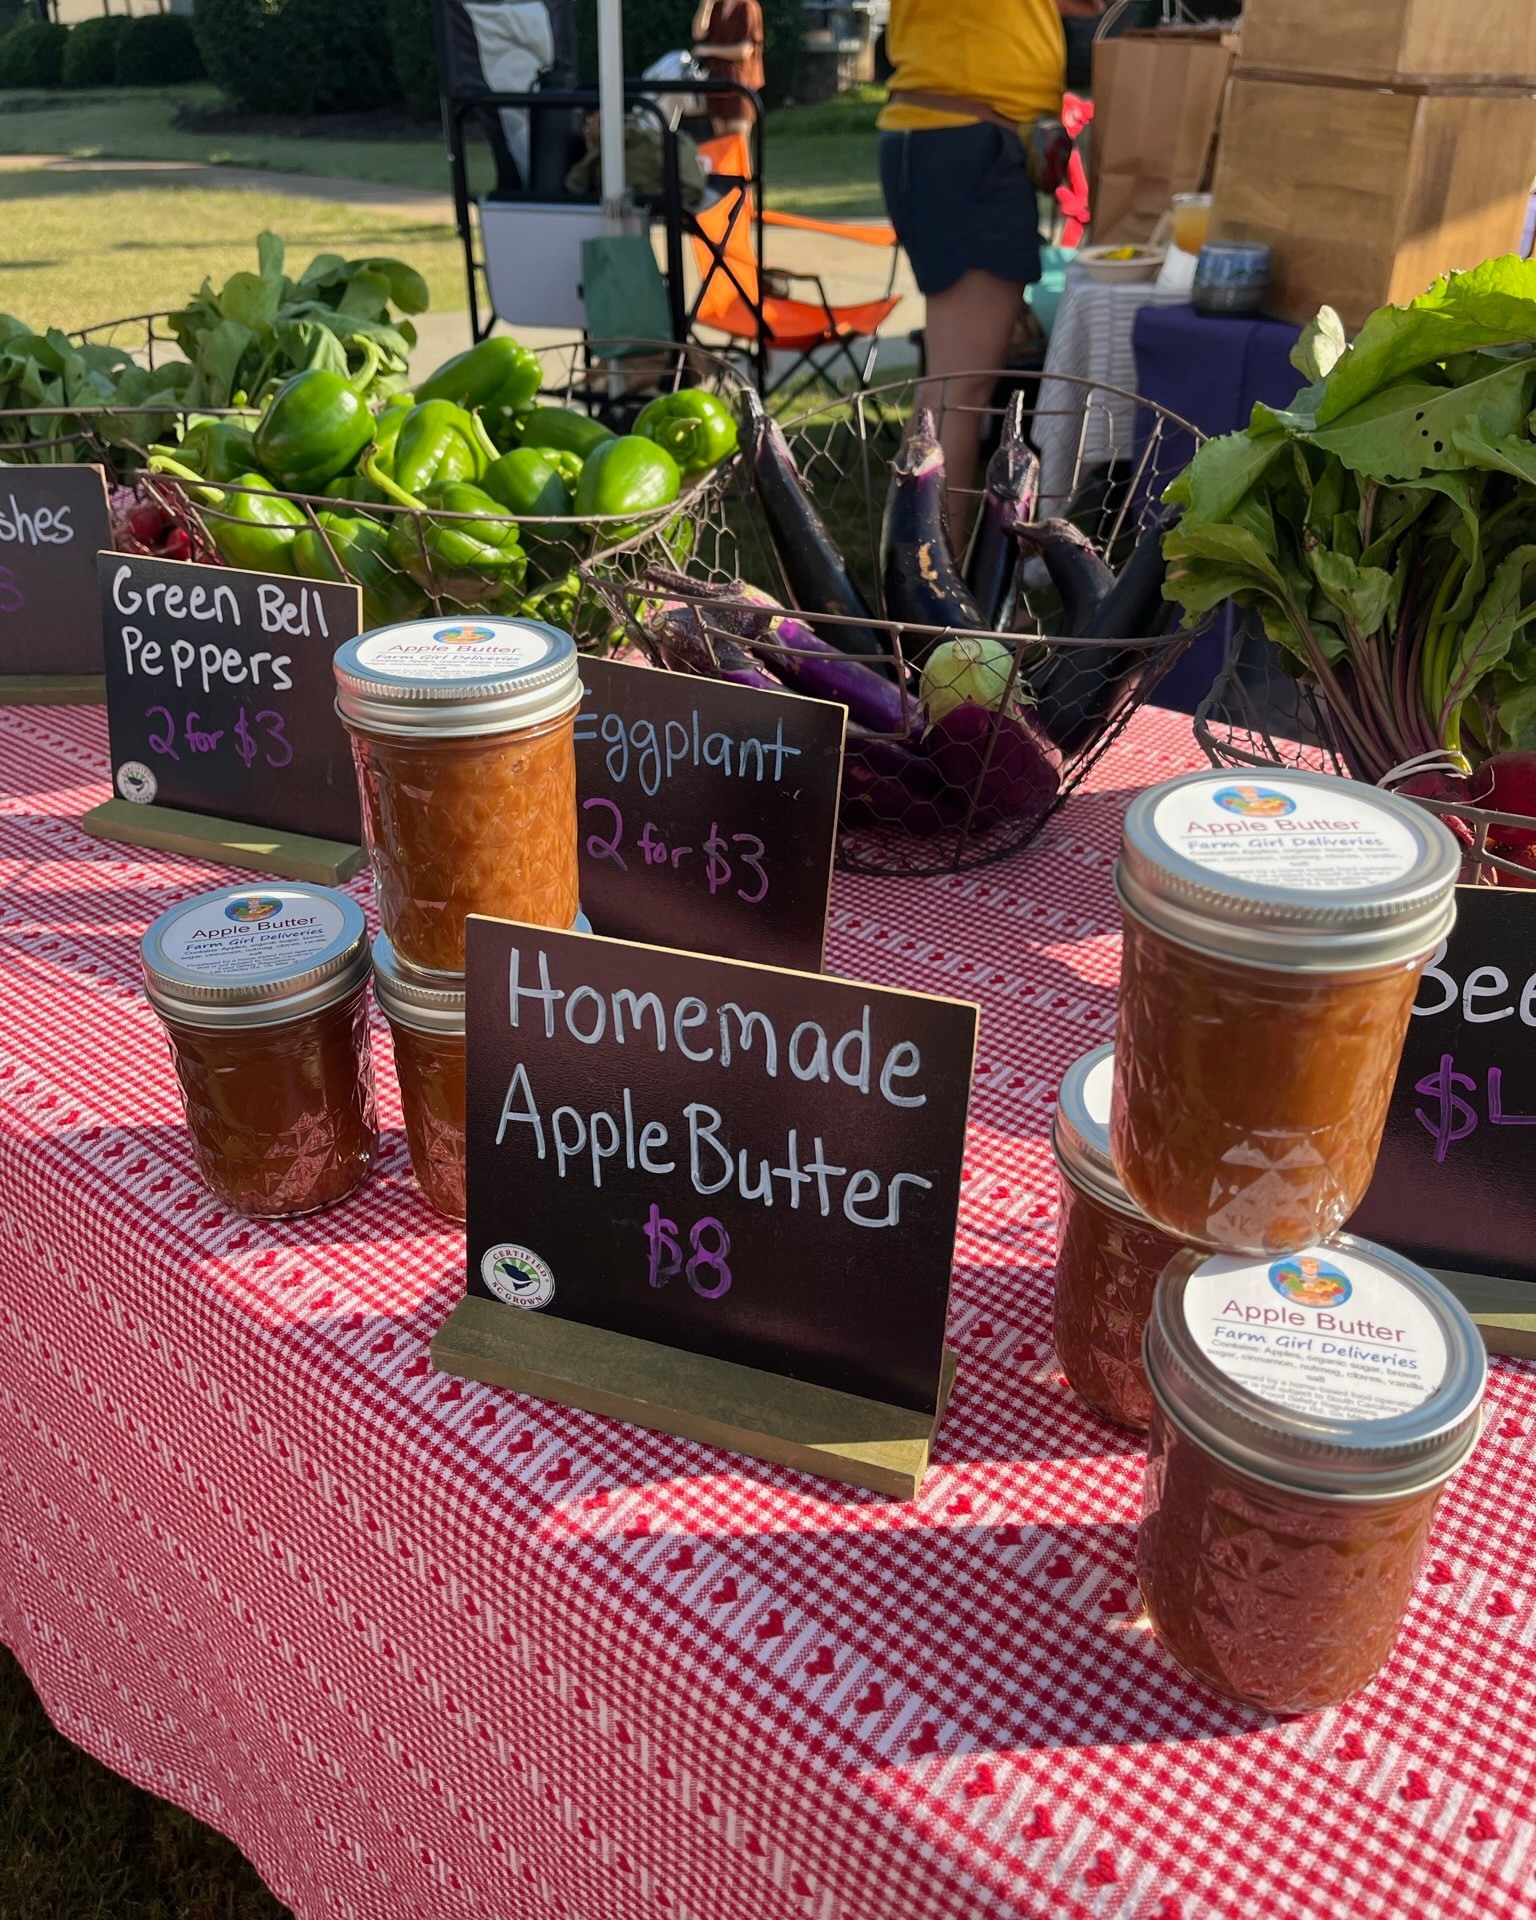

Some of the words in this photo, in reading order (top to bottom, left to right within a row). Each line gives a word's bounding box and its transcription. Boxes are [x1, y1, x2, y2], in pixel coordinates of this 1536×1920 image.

[112, 564, 243, 627] Green
[257, 583, 331, 638] Bell
[121, 625, 294, 693] Peppers
[389, 644, 449, 653] Apple
[457, 645, 521, 653] Butter
[145, 705, 181, 761] 2
[184, 711, 224, 753] for
[234, 706, 294, 768] $3
[1187, 819, 1269, 836] Apple
[1274, 819, 1360, 831] Butter
[1188, 840, 1241, 850] Farm
[1248, 838, 1285, 848] Girl
[1291, 836, 1384, 847] Deliveries
[582, 797, 628, 872] 2
[637, 822, 693, 868] for
[703, 822, 769, 903] $3
[186, 940, 223, 951] Farm
[228, 936, 254, 946] Girl
[260, 927, 324, 942] Deliveries
[192, 925, 250, 939] Apple
[257, 917, 317, 931] Butter
[509, 947, 927, 1108] Homemade
[495, 1063, 676, 1187] Apple
[683, 1102, 933, 1228] Butter
[642, 1203, 733, 1300] $8
[492, 1281, 504, 1294] SC
[505, 1295, 543, 1306] GROWN
[1222, 1299, 1306, 1326] Apple
[1316, 1312, 1406, 1342] Butter
[1214, 1326, 1266, 1344] Farm
[1275, 1336, 1313, 1351] Girl
[1321, 1342, 1419, 1370] Deliveries
